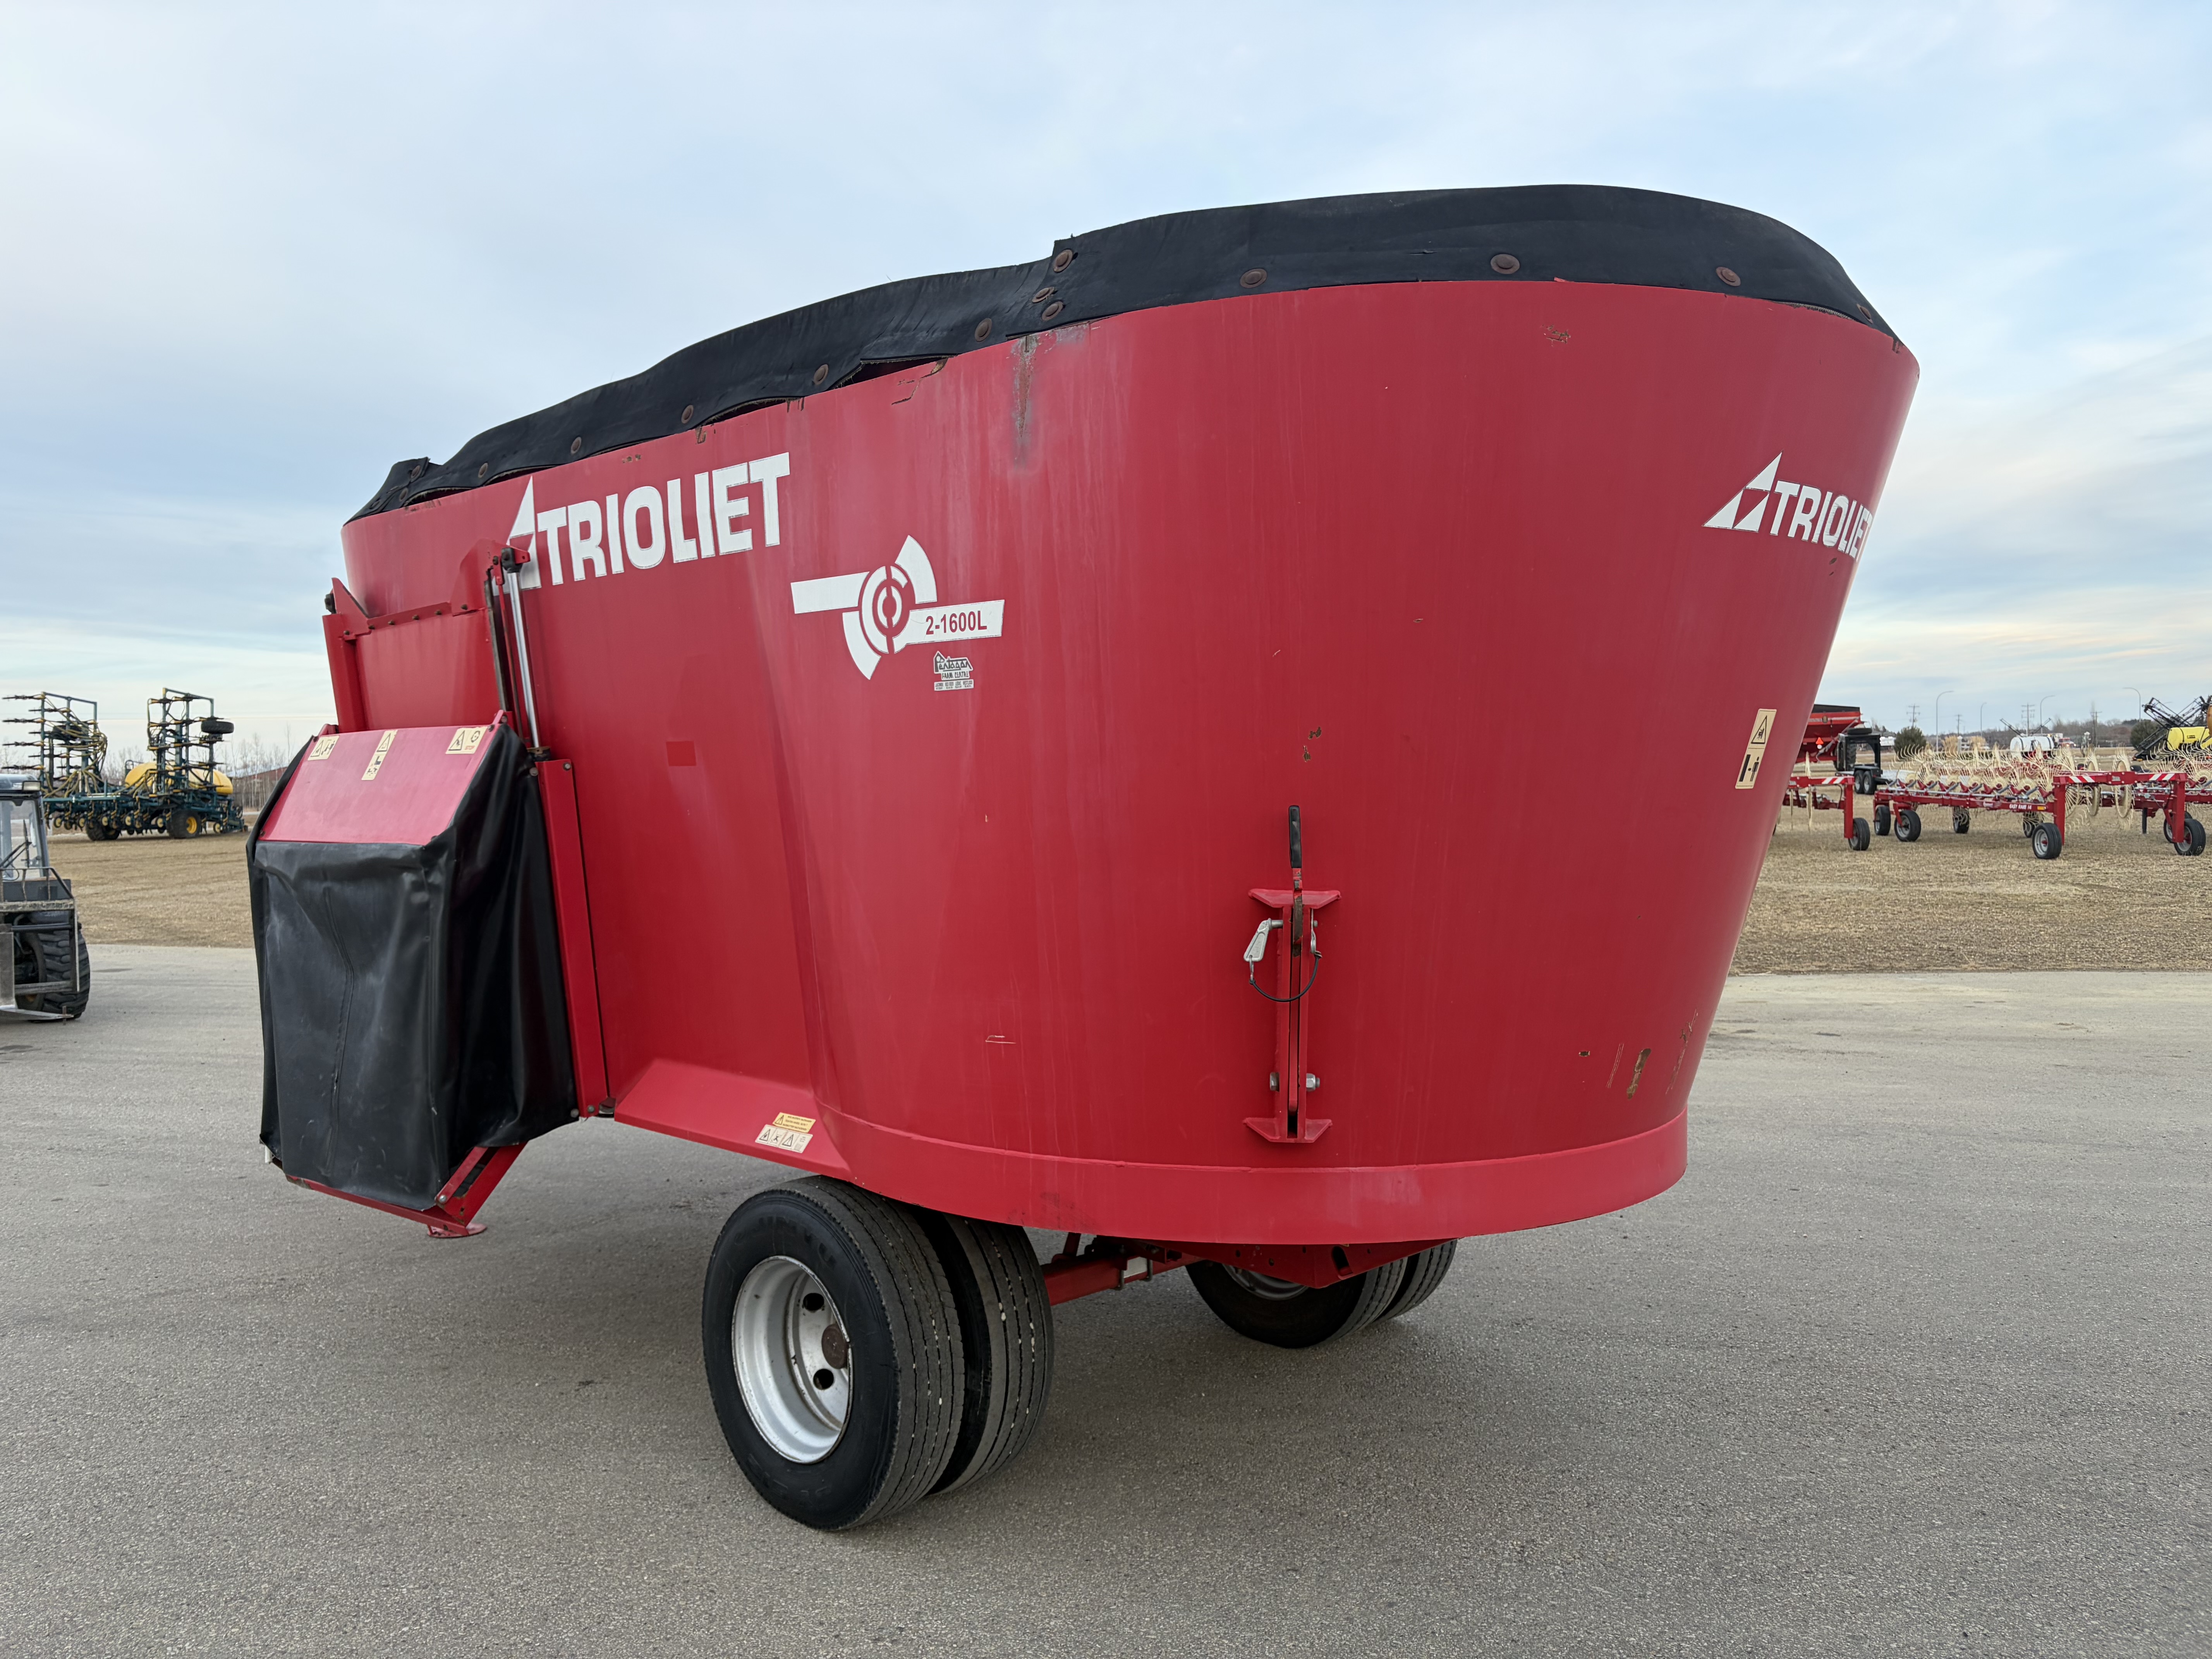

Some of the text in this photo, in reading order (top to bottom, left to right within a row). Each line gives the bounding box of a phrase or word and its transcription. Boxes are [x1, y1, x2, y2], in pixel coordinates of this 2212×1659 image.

[537, 452, 790, 586] TRIOLIET
[926, 610, 987, 635] 2-1600L
[934, 652, 972, 673] Pentagon
